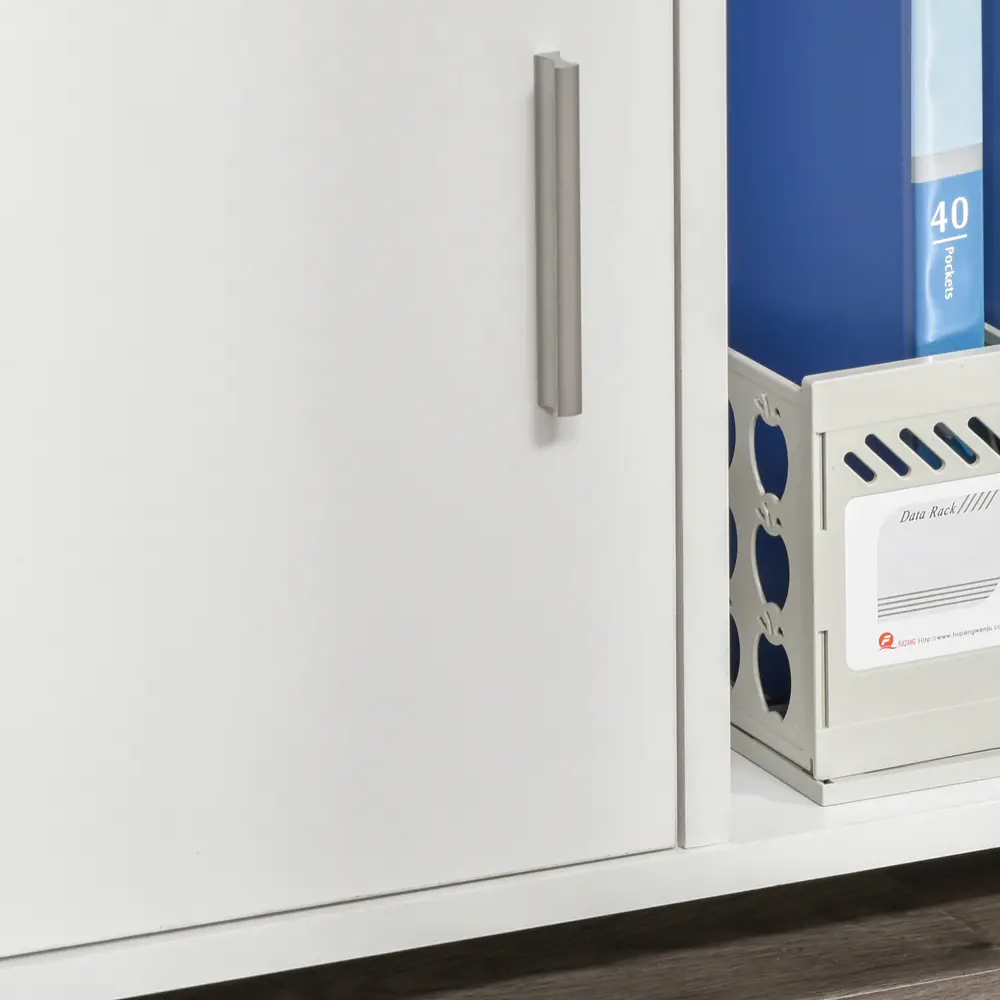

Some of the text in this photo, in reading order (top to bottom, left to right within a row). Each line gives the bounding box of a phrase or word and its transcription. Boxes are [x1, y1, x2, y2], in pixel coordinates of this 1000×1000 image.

[930, 196, 969, 233] 40
[944, 246, 955, 300] Pockets
[900, 501, 957, 523] Data Rack
